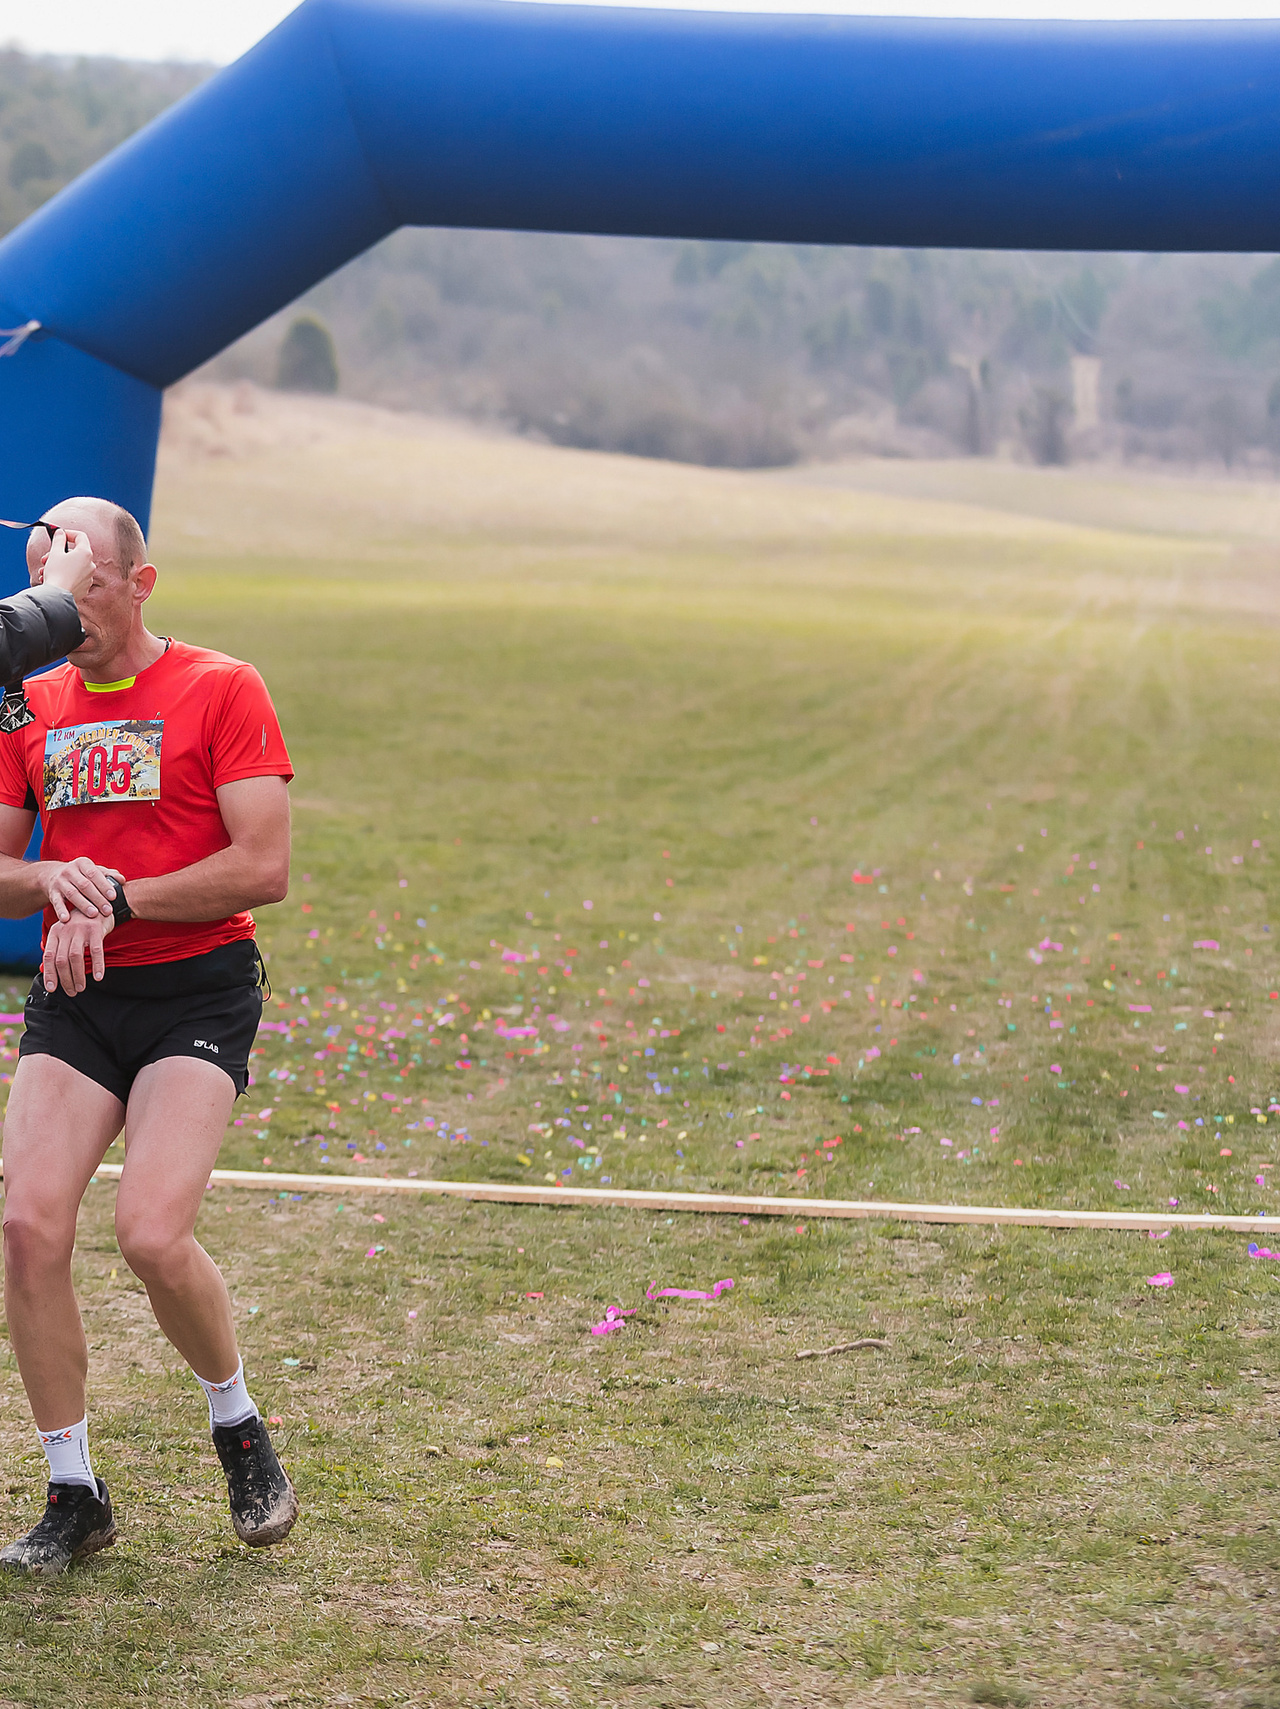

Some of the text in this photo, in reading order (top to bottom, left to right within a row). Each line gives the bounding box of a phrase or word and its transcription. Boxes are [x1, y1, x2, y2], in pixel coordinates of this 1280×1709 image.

[53, 730, 63, 742] 12
[122, 731, 151, 754] TRAIL
[67, 744, 132, 799] 105
